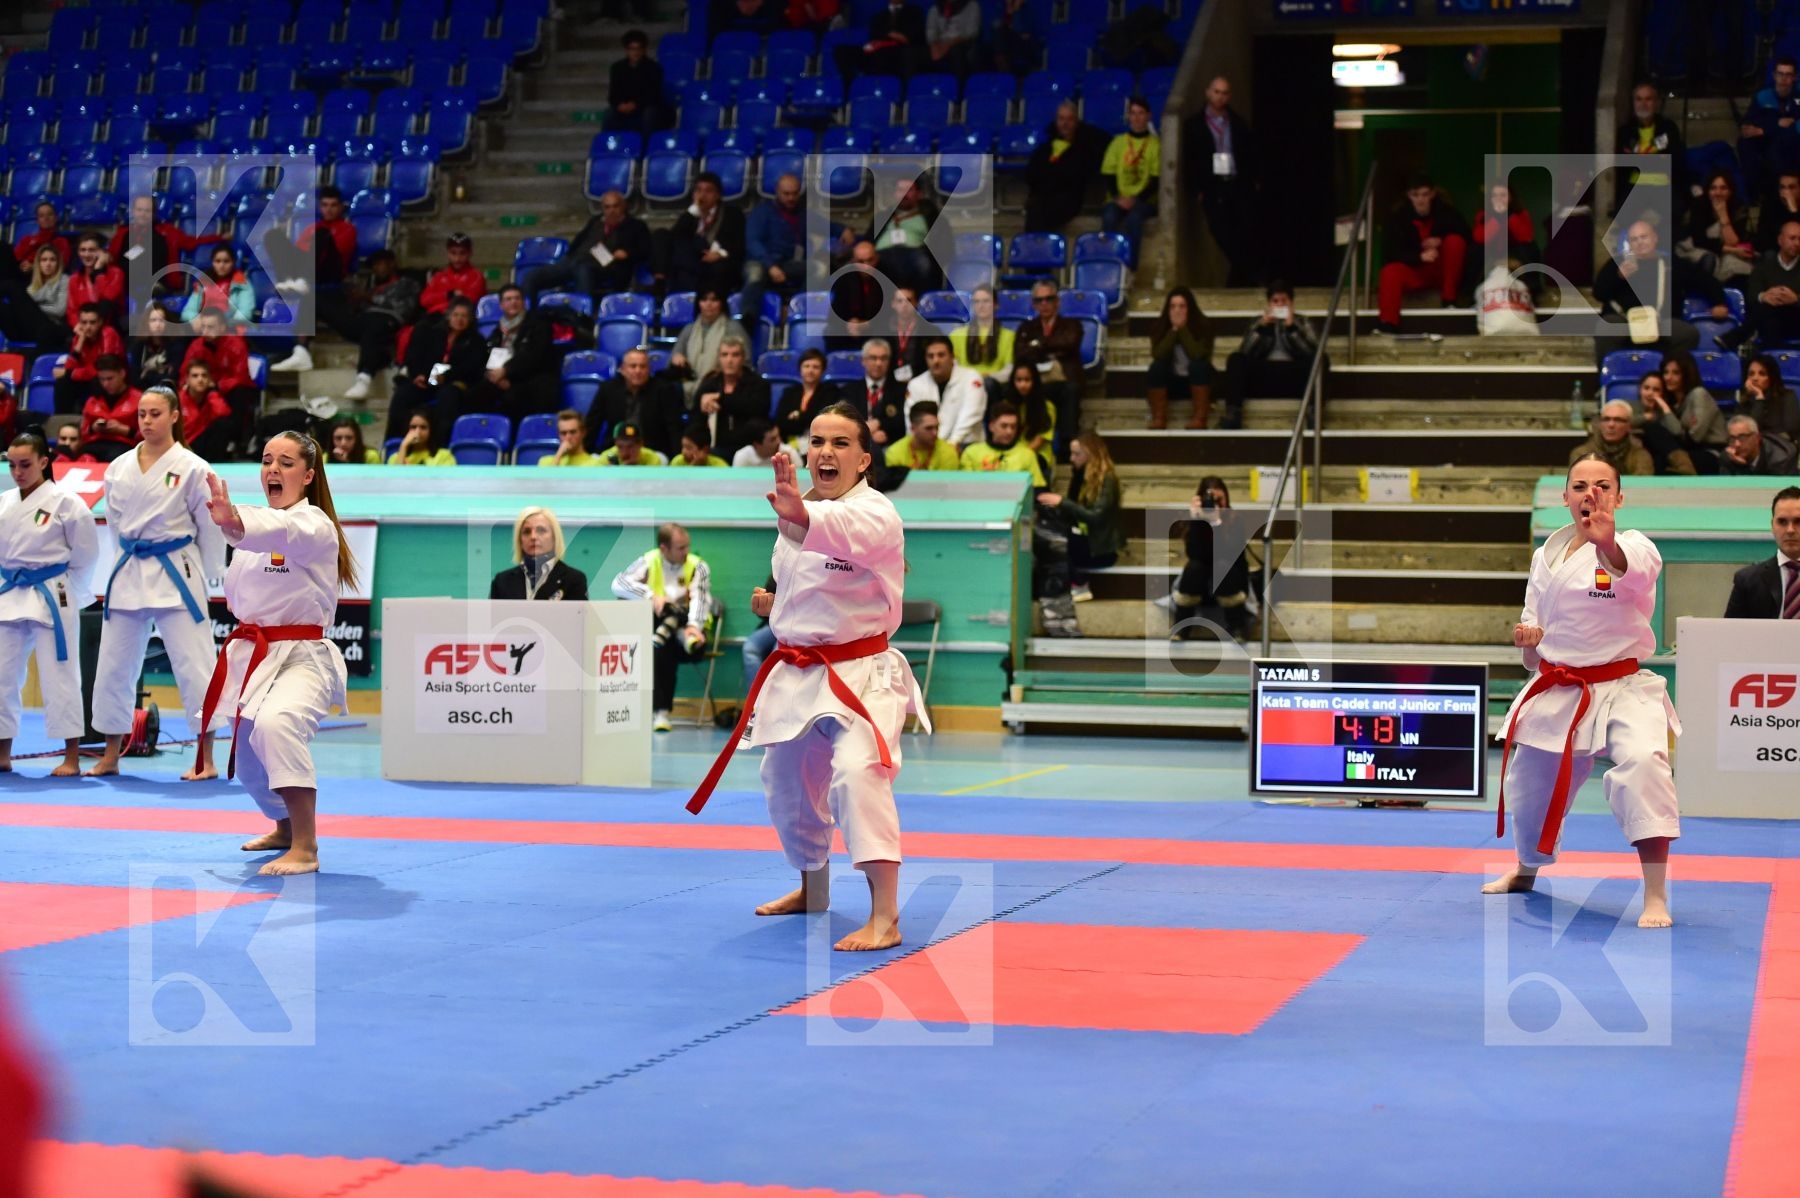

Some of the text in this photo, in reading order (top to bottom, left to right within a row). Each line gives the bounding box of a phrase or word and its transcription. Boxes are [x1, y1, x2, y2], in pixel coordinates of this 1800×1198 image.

[825, 562, 854, 572] ESPAÑA
[1588, 590, 1616, 599] ESPAÑA
[424, 643, 507, 676] ASC
[1259, 668, 1320, 681] TATAMI 5
[425, 681, 537, 695] Asia Sport Center
[1262, 696, 1293, 709] Kata
[1294, 696, 1329, 709] Team
[1331, 697, 1370, 710] Cadet
[1372, 697, 1397, 711] and
[1399, 698, 1441, 711] Junior
[448, 707, 513, 724] asc.ch
[606, 706, 630, 724] asc.ch
[1730, 714, 1762, 727] Asia
[1347, 751, 1375, 766] Italy
[1377, 768, 1417, 781] ITALY
